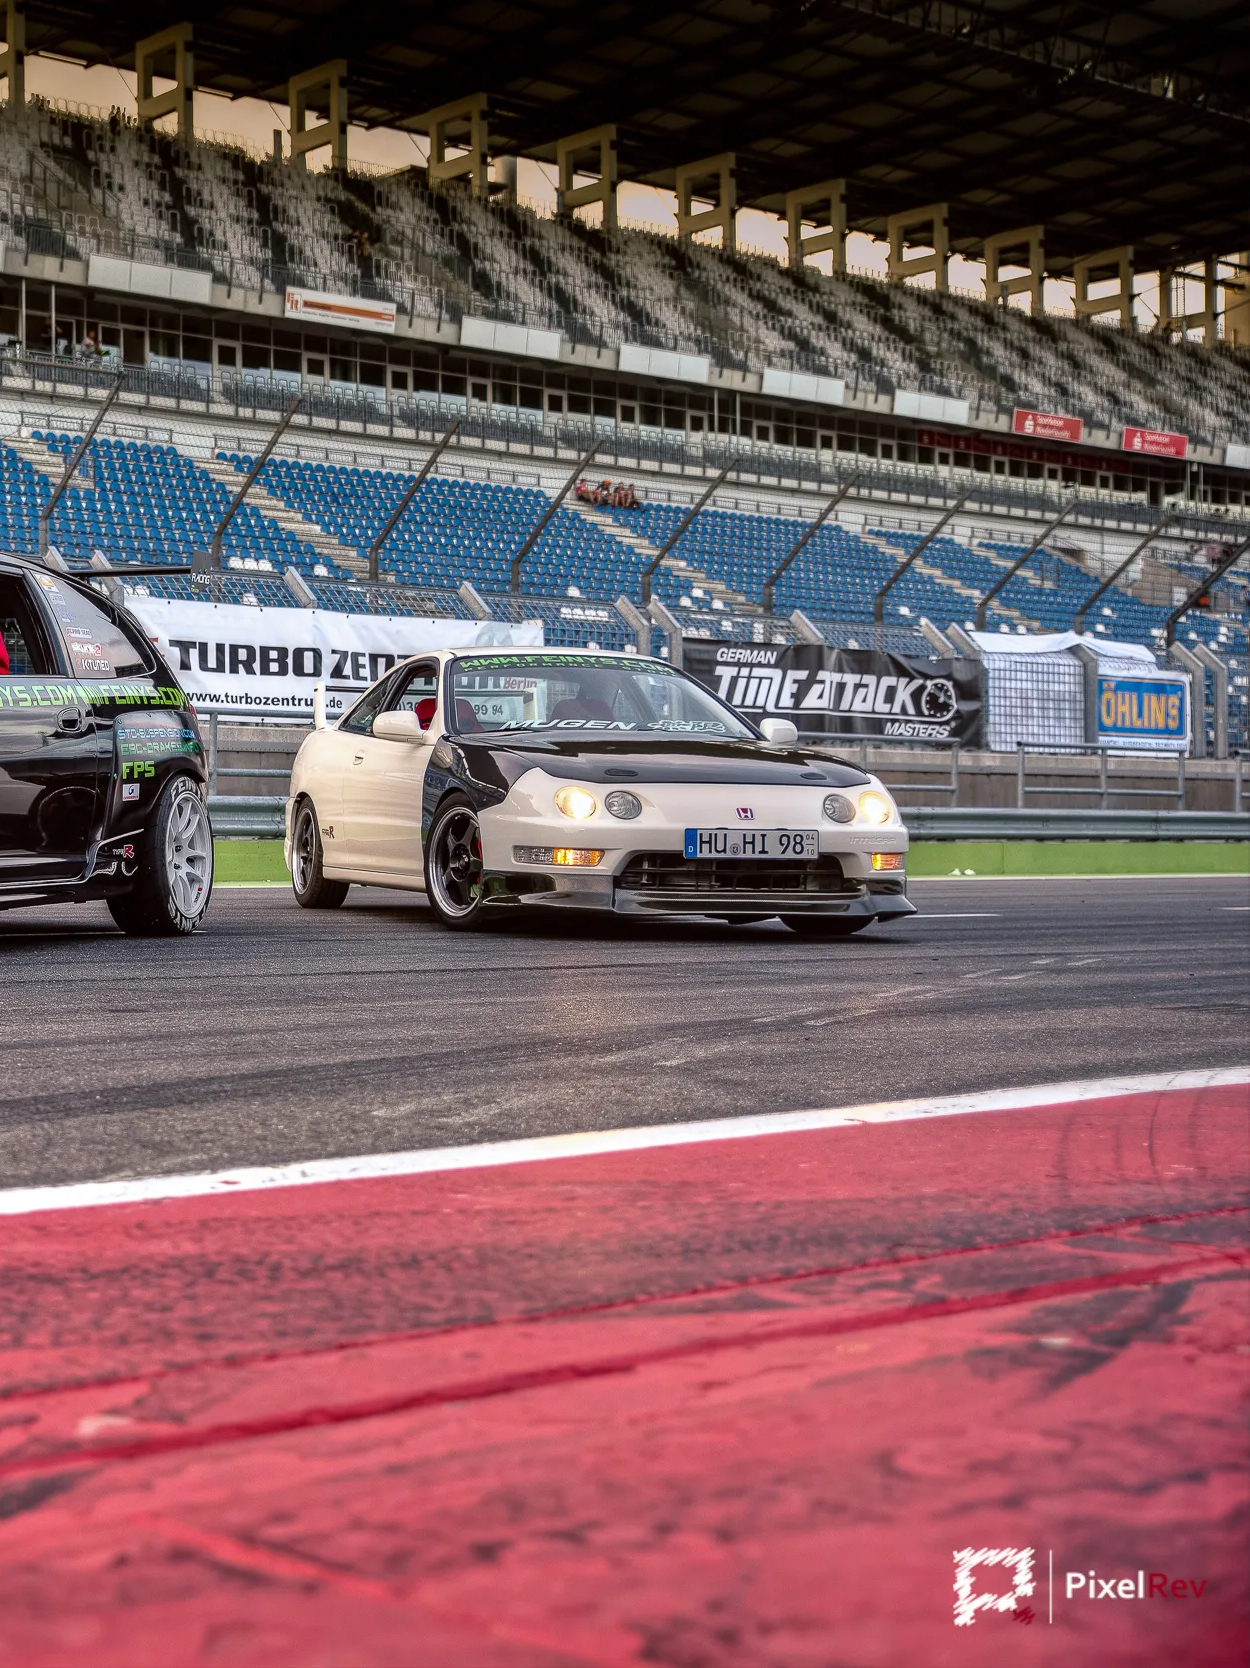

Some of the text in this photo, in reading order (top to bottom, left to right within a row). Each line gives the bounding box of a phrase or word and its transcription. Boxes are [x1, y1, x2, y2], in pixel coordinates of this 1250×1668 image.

[191, 572, 210, 585] RACING
[168, 639, 323, 678] TURBO
[716, 647, 778, 664] GERMAN
[459, 655, 676, 674] WWW.FEINYS.COM
[713, 665, 924, 715] TIME ATTACK
[186, 691, 343, 709] www.turbozentru.de
[500, 719, 637, 730] MUGEN
[122, 761, 155, 780] FPS
[699, 832, 728, 854] HU
[742, 833, 768, 855] HI
[778, 833, 805, 855] 98
[805, 833, 815, 841] 04
[849, 836, 897, 844] INTEGRA
[122, 844, 135, 859] R
[805, 848, 815, 856] 10
